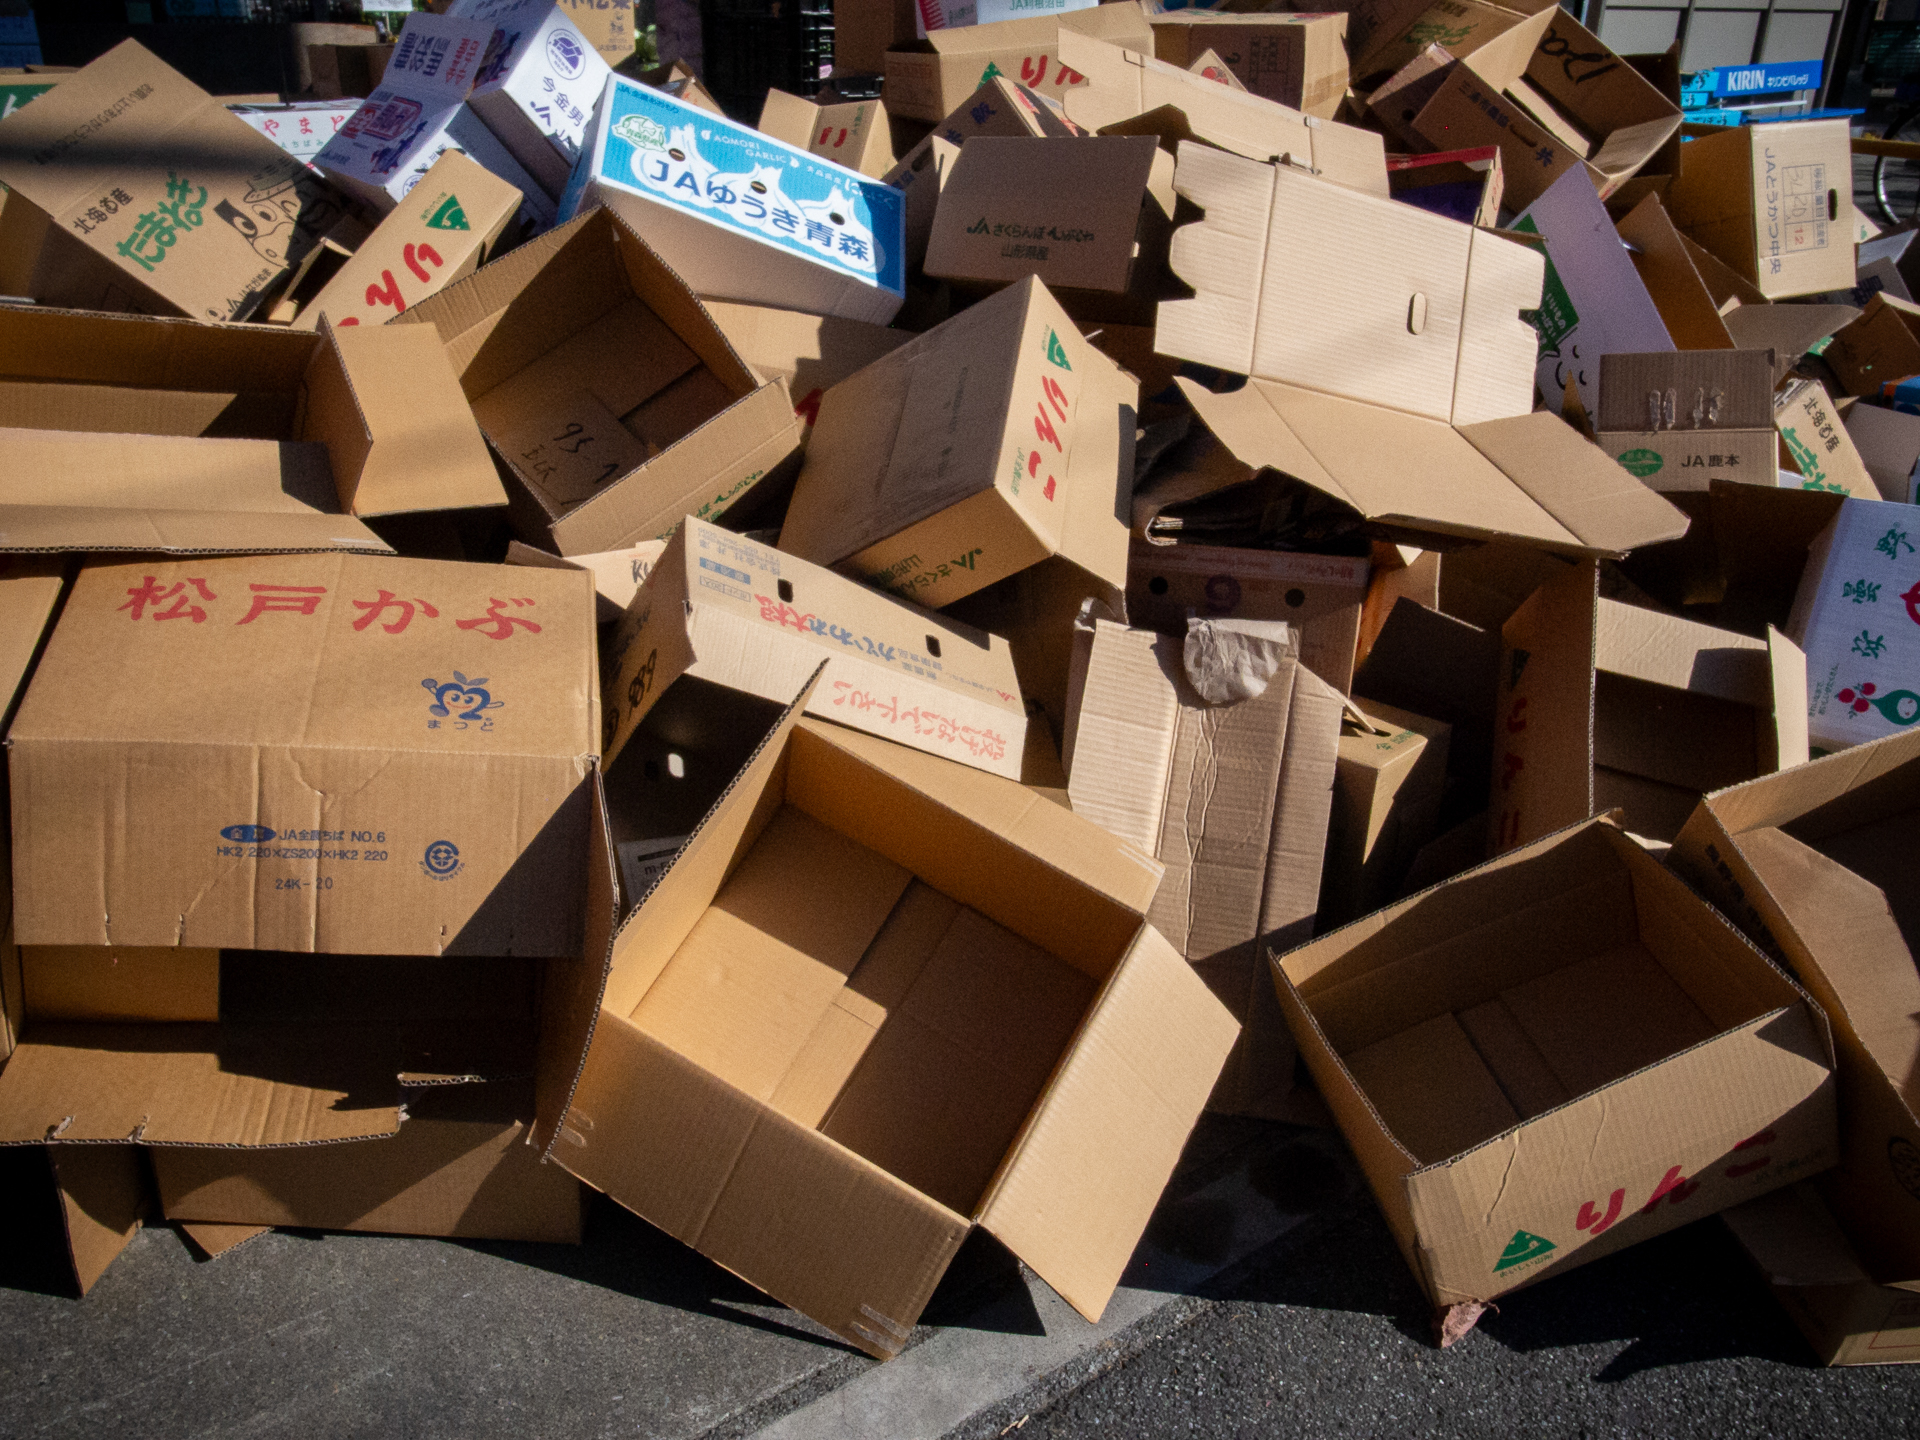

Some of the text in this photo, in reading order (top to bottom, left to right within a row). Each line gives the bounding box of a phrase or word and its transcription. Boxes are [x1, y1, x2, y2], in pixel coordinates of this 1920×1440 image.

[543, 74, 586, 128] 今金男
[1728, 70, 1765, 92] KIRIN
[714, 135, 761, 150] AOMORI
[746, 149, 788, 164] GARLIC
[73, 186, 134, 235] 北海道産
[116, 171, 208, 272] たまねぎ
[649, 159, 870, 263] JAゆうき青森
[1764, 147, 1781, 275] JAとうかつ中央
[1795, 227, 1804, 245] 12
[337, 241, 443, 327] りん
[1029, 375, 1069, 502] りんご
[1802, 396, 1842, 454] 北海道産
[1682, 453, 1741, 468] JA鹿本
[119, 576, 543, 640] 松戸かぶ
[427, 717, 495, 733] まつど
[834, 679, 1007, 762] 投げないで下さい
[216, 846, 243, 858] HK2
[363, 850, 389, 862] 220
[279, 830, 345, 843] JA全農ちば
[350, 831, 387, 844] NO.6
[1576, 1131, 1775, 1235] りんご
